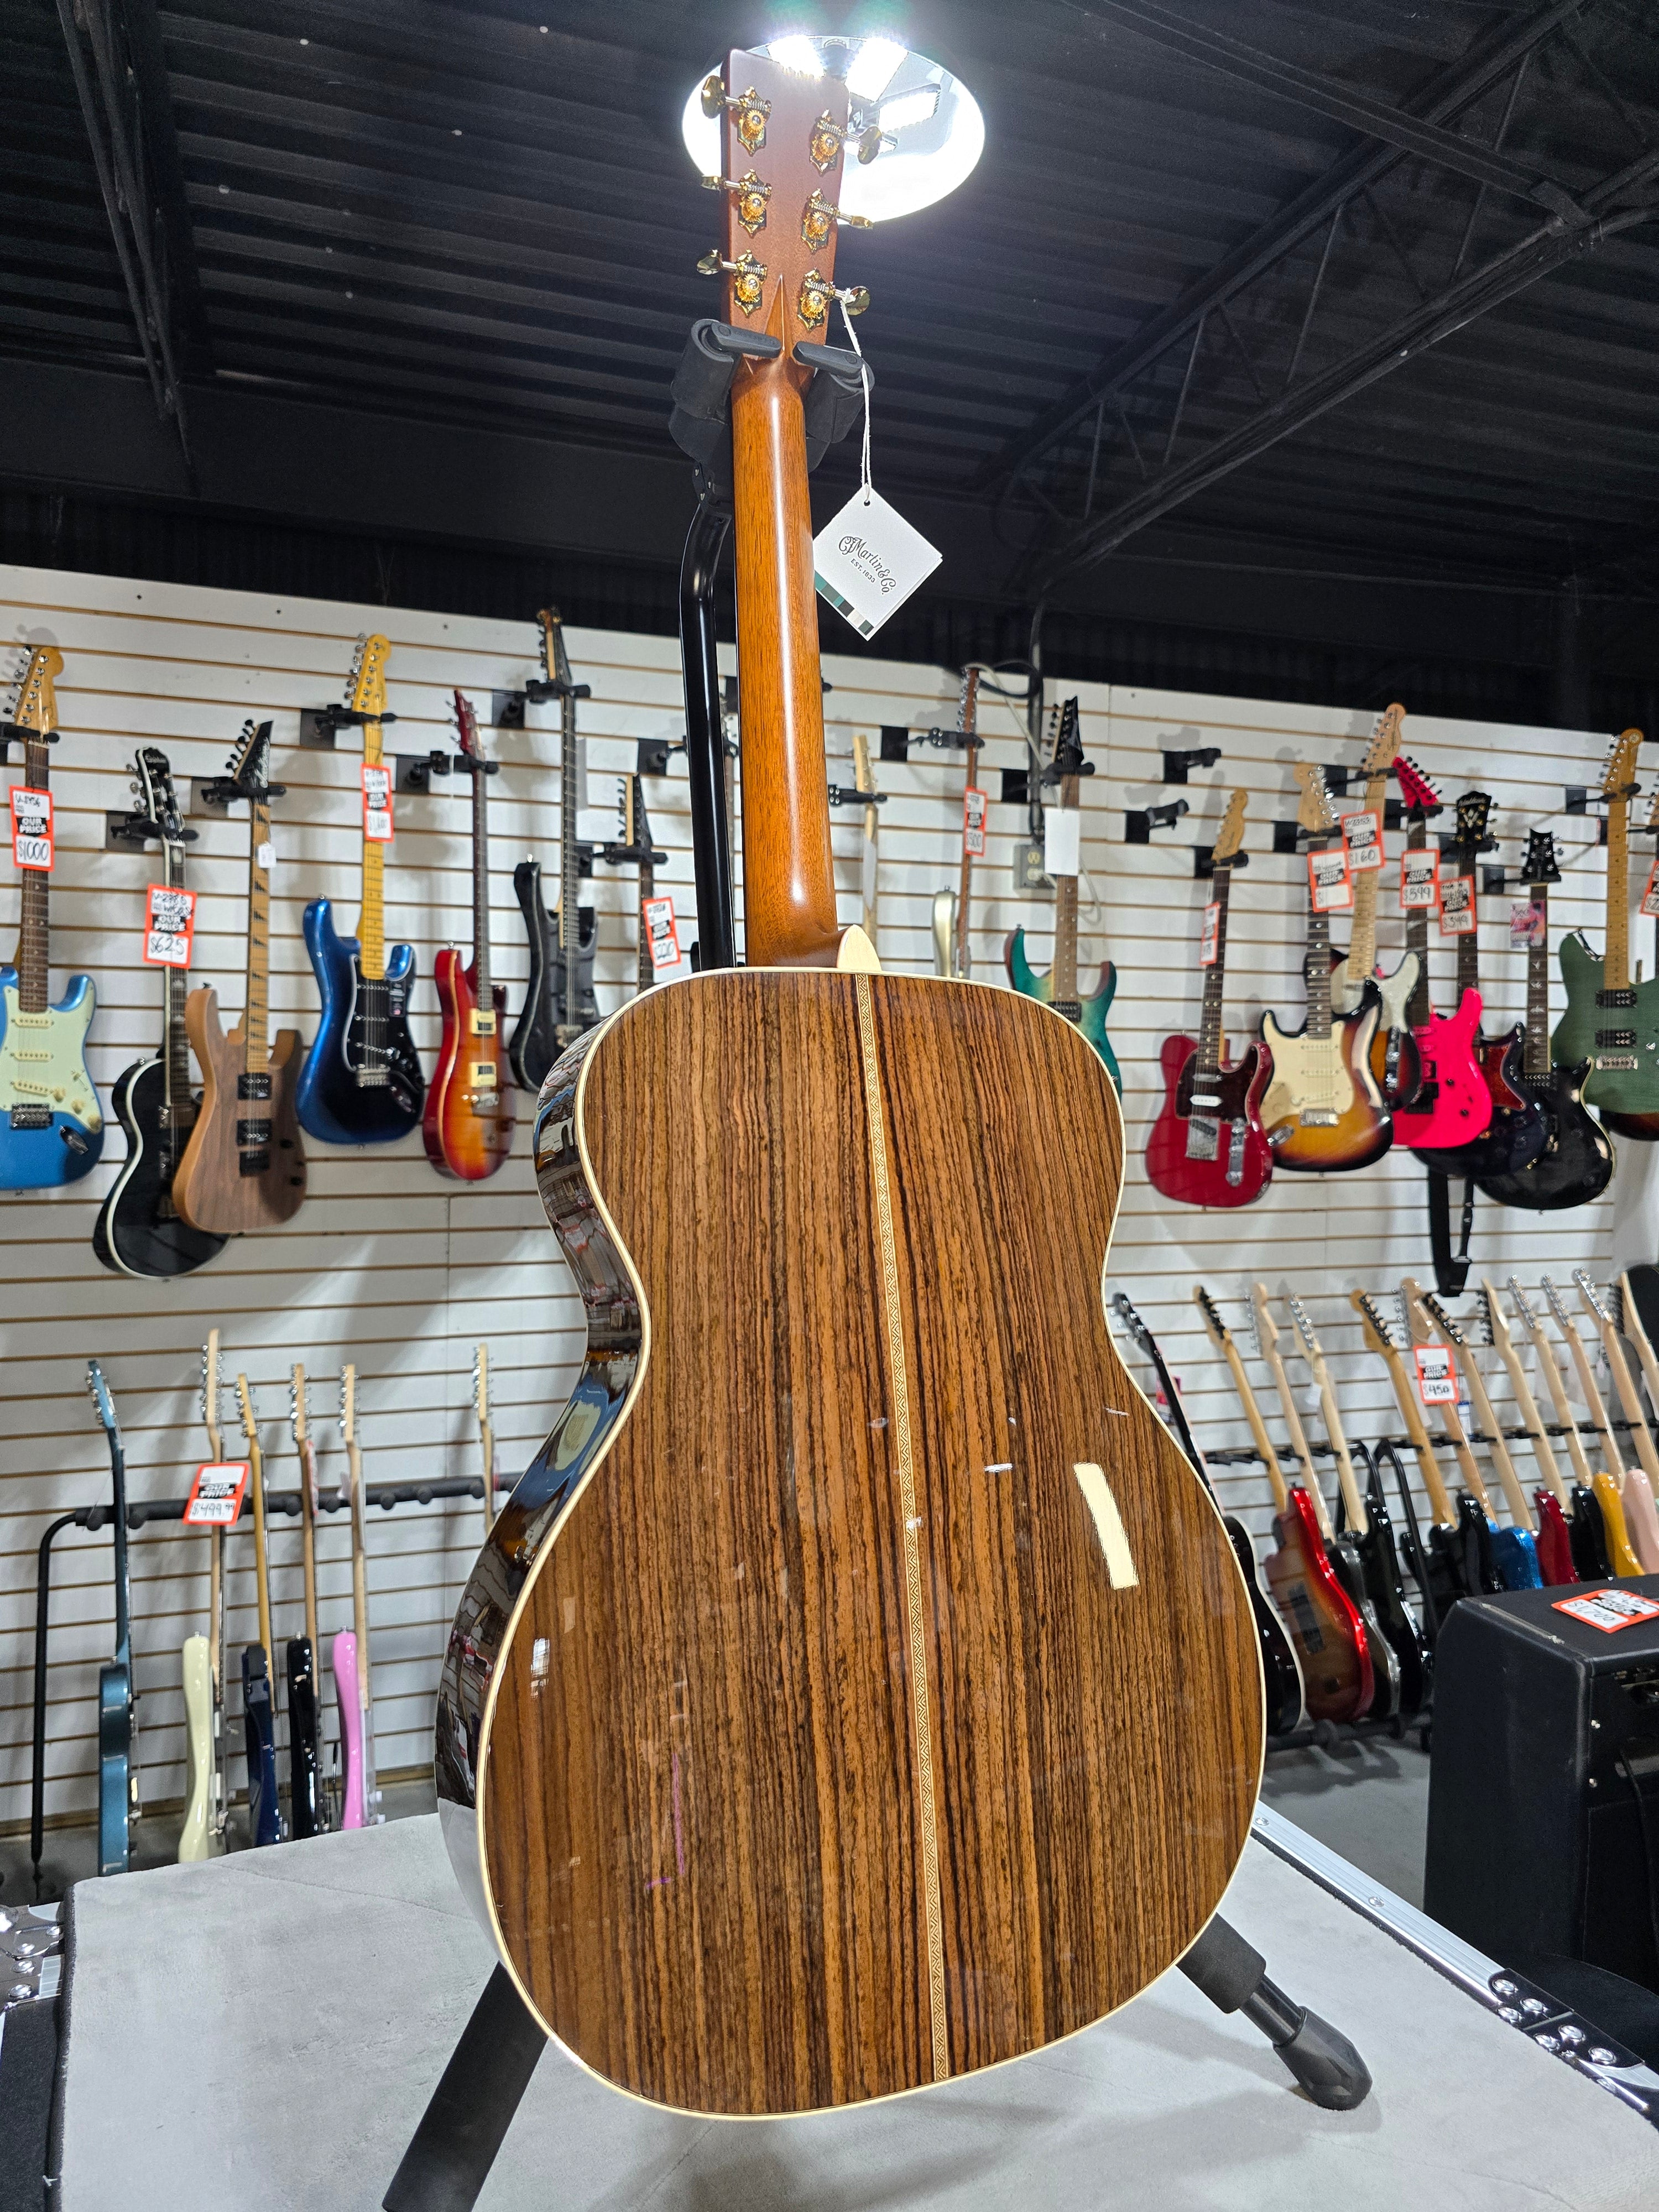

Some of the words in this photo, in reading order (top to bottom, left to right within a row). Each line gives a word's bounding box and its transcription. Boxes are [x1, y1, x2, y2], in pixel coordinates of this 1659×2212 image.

[851, 559, 863, 572] EST.
[862, 569, 876, 583] 1833
[21, 817, 42, 826] OUR
[19, 824, 47, 833] PRICE
[1352, 832, 1371, 841] OUR
[1350, 836, 1376, 848] PRICE
[158, 916, 181, 924] OUR
[154, 921, 185, 931] PRICE
[150, 936, 185, 955] $625
[1423, 1370, 1448, 1379] PRICE
[1423, 1384, 1449, 1396] $450
[199, 1488, 234, 1498] PRICE
